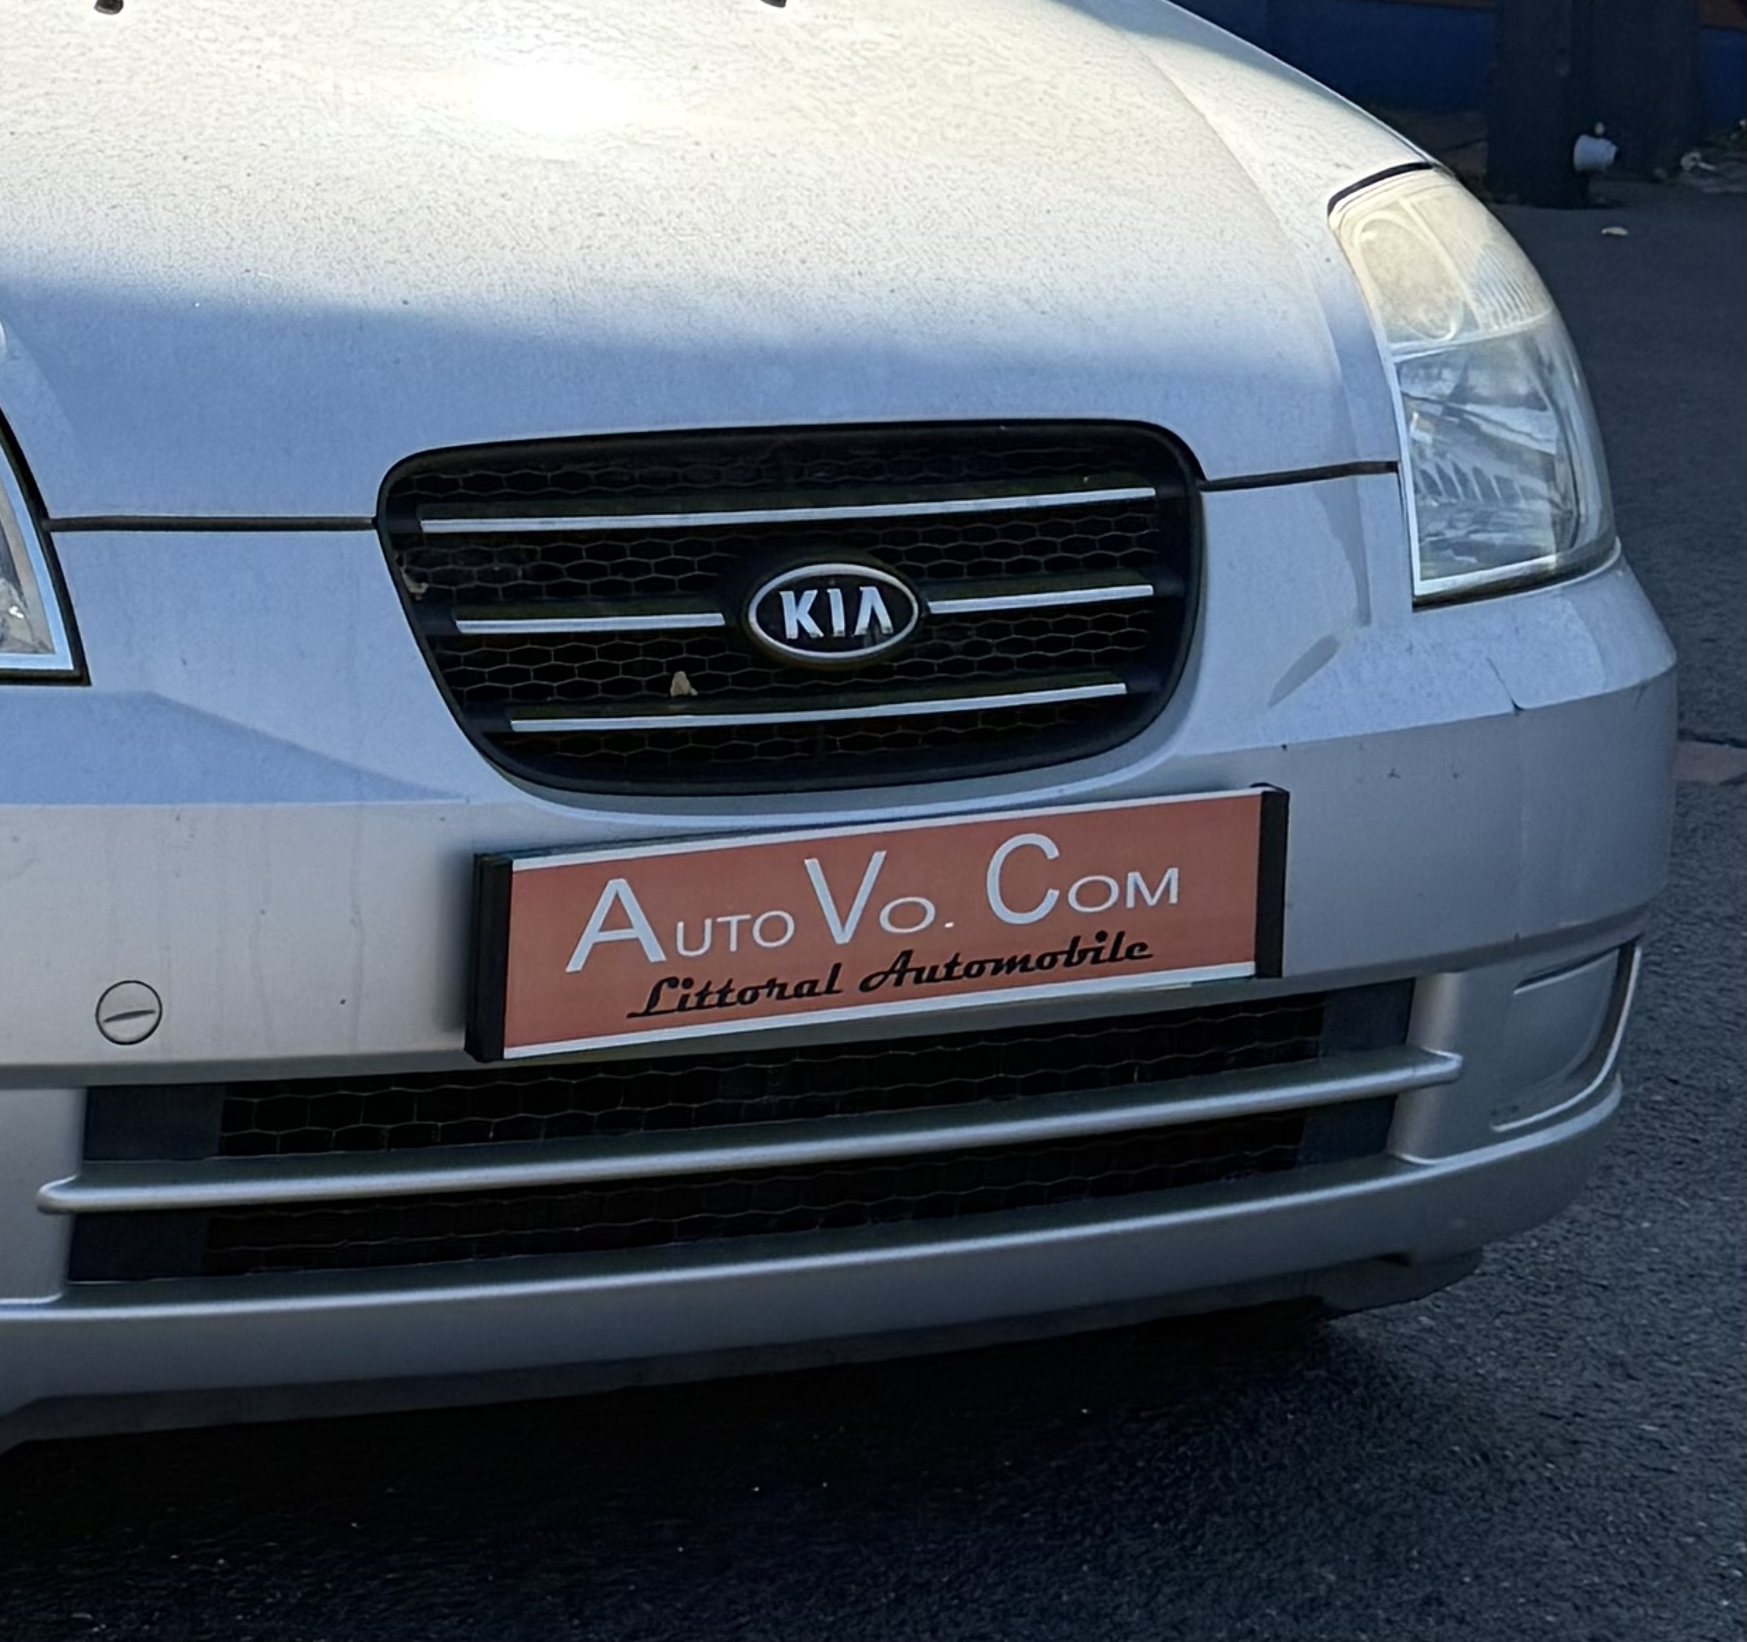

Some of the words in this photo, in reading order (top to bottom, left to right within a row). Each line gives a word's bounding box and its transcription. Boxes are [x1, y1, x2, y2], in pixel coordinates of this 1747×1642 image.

[778, 585, 895, 641] KIA
[626, 964, 844, 1020] Littoral
[858, 930, 1154, 995] Automobile
